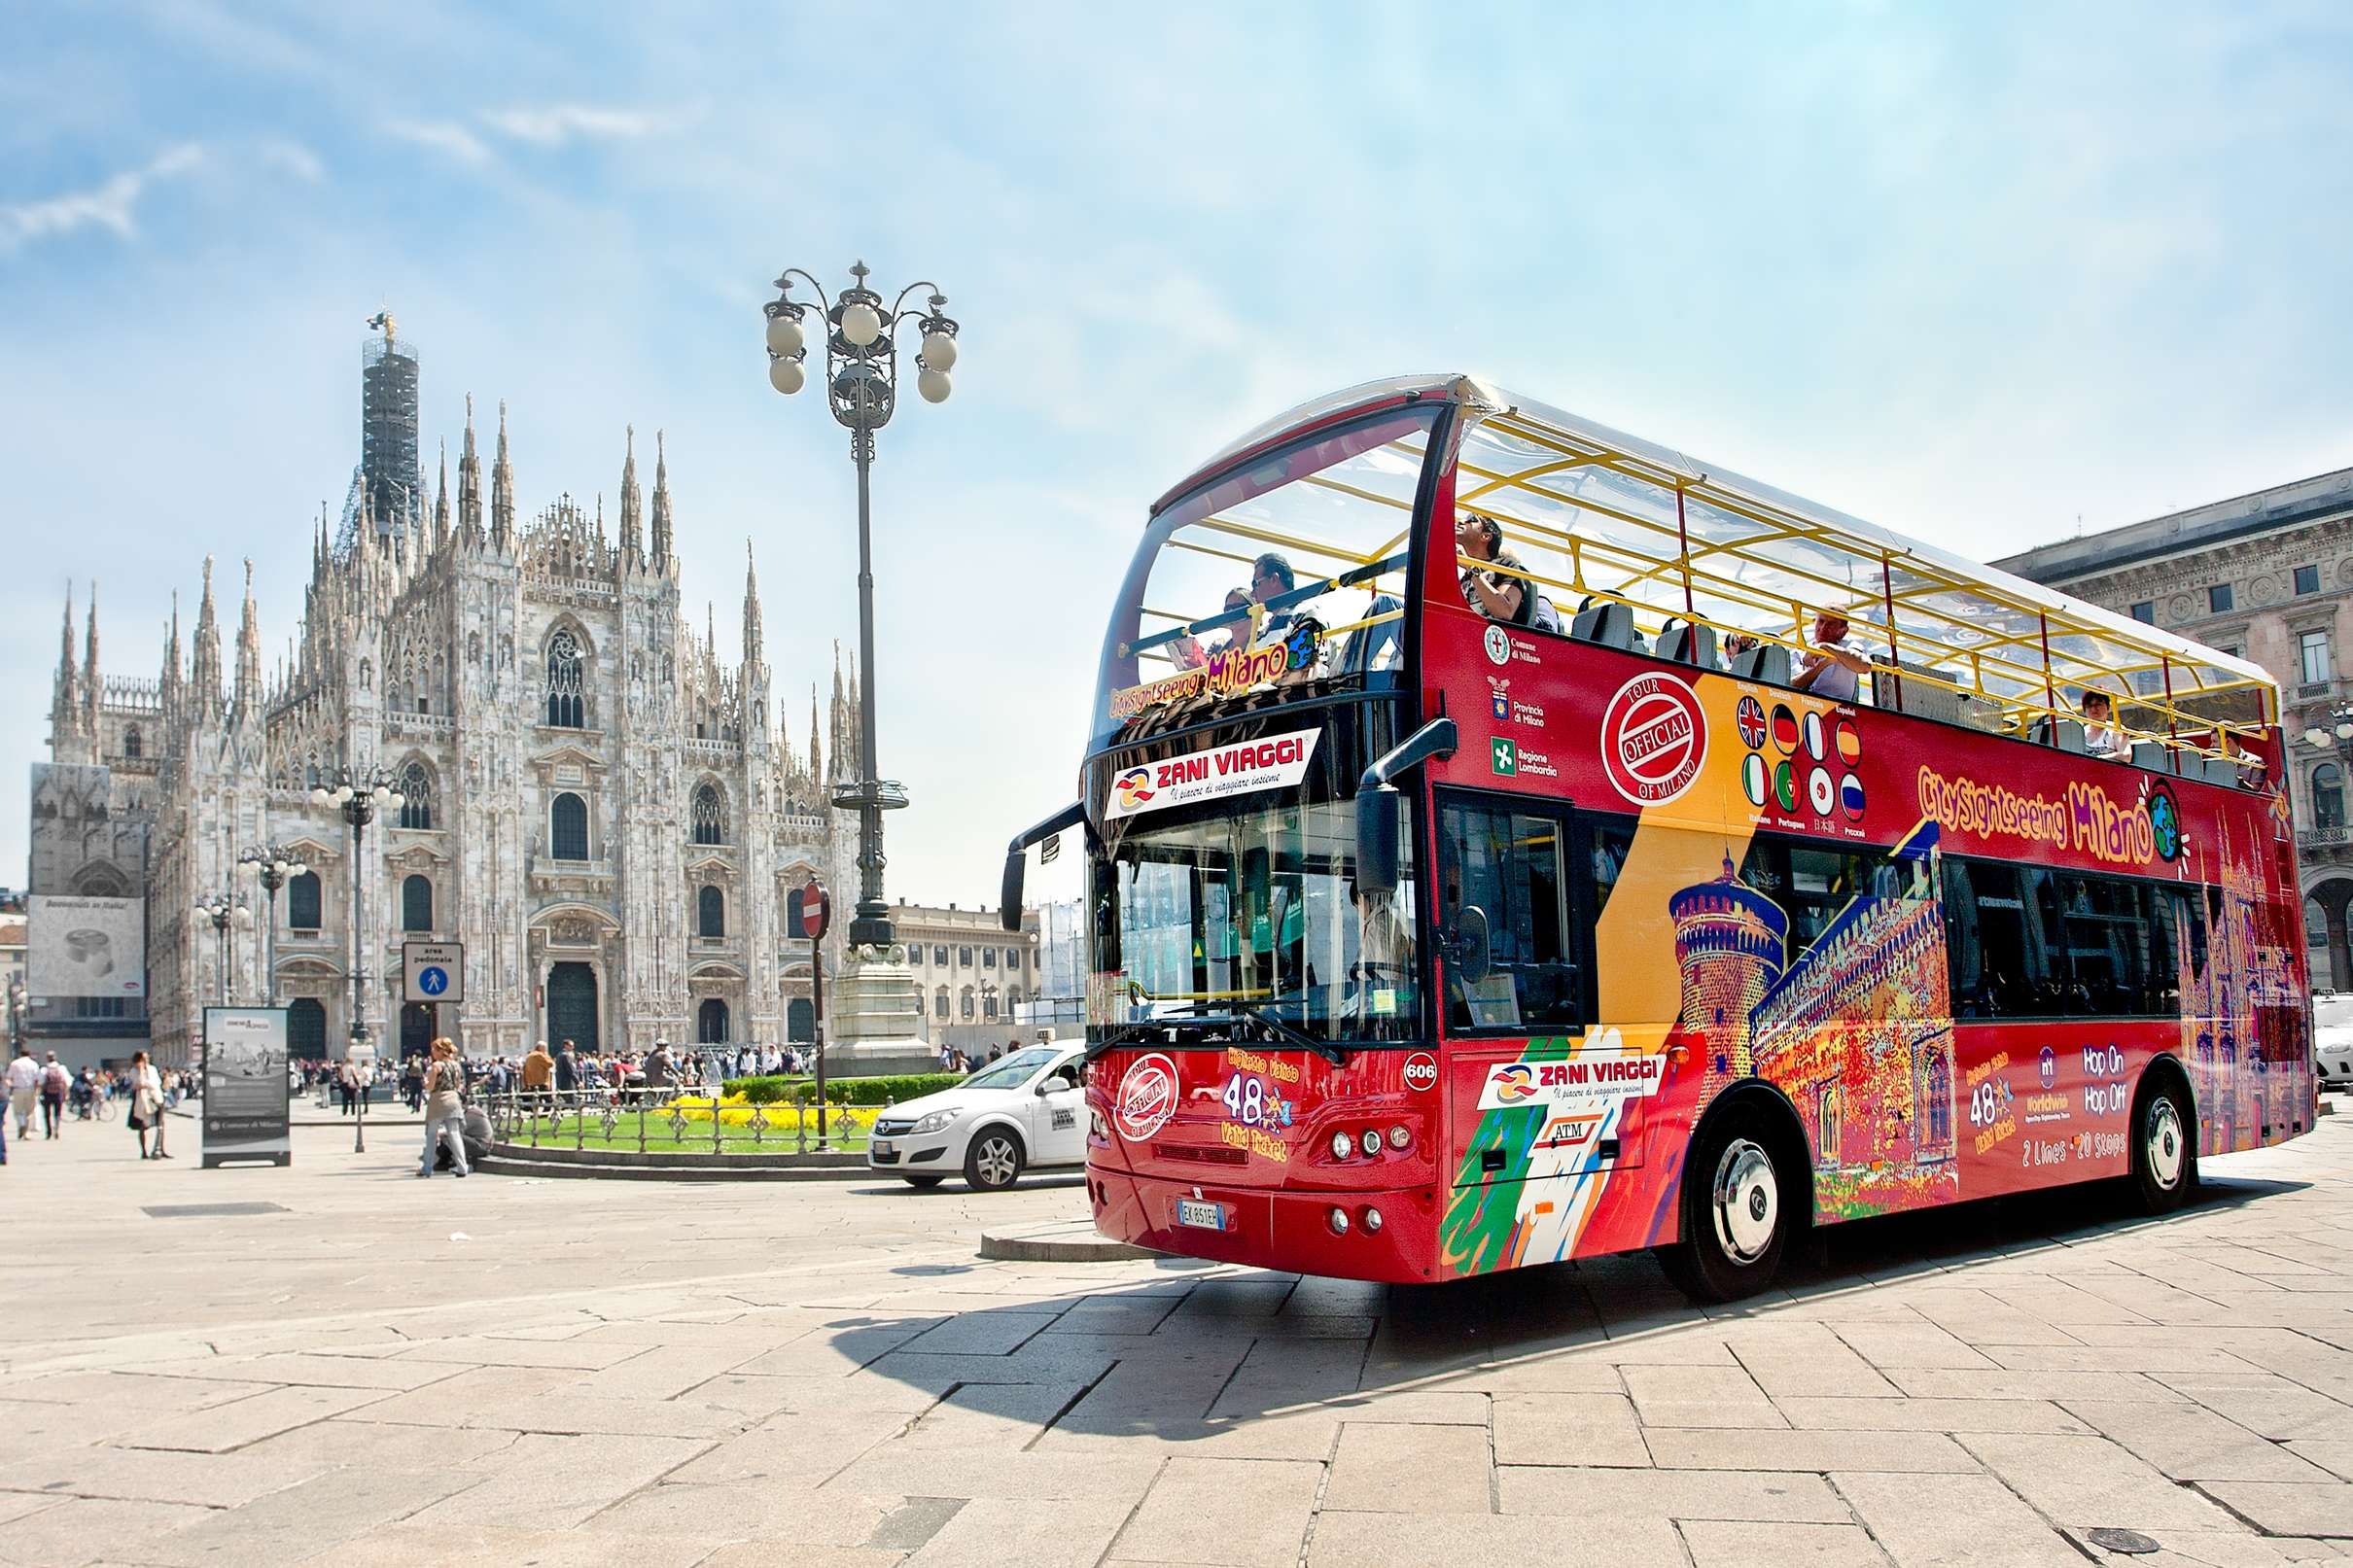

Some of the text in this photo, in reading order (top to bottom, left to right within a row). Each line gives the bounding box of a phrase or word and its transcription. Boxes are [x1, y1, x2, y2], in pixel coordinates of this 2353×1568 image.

[1510, 638, 1536, 652] Comune
[1511, 650, 1541, 665] di Milano
[1625, 679, 1661, 703] TOUR
[1513, 701, 1544, 716] Provincia
[1514, 714, 1544, 727] di Milano
[1624, 714, 1690, 761] OFFICIAL
[1157, 738, 1303, 788] ZANI VIAGGI
[1518, 749, 1548, 764] Regione
[1519, 761, 1558, 777] Lombardia
[1179, 785, 1204, 801] piacere
[1206, 782, 1212, 794] di
[1214, 779, 1249, 794] viaggiare
[1251, 773, 1281, 785] insieme
[1638, 759, 1696, 799] OF MILANO
[2069, 781, 2155, 865] Milano
[1131, 1059, 1150, 1079] TOUR
[1406, 1063, 1435, 1079] 606
[1540, 1060, 1658, 1086] ZANI VIAGGI
[2083, 1044, 2124, 1078] Hop On
[1126, 1078, 1167, 1113] OFFICIAL
[1223, 1073, 1263, 1124] 48
[1563, 1090, 1584, 1100] piacere
[1970, 1082, 1996, 1128] 48
[2084, 1082, 2126, 1116] Hop Off
[1556, 1123, 1582, 1139] ATM
[2022, 1139, 2031, 1167] 2
